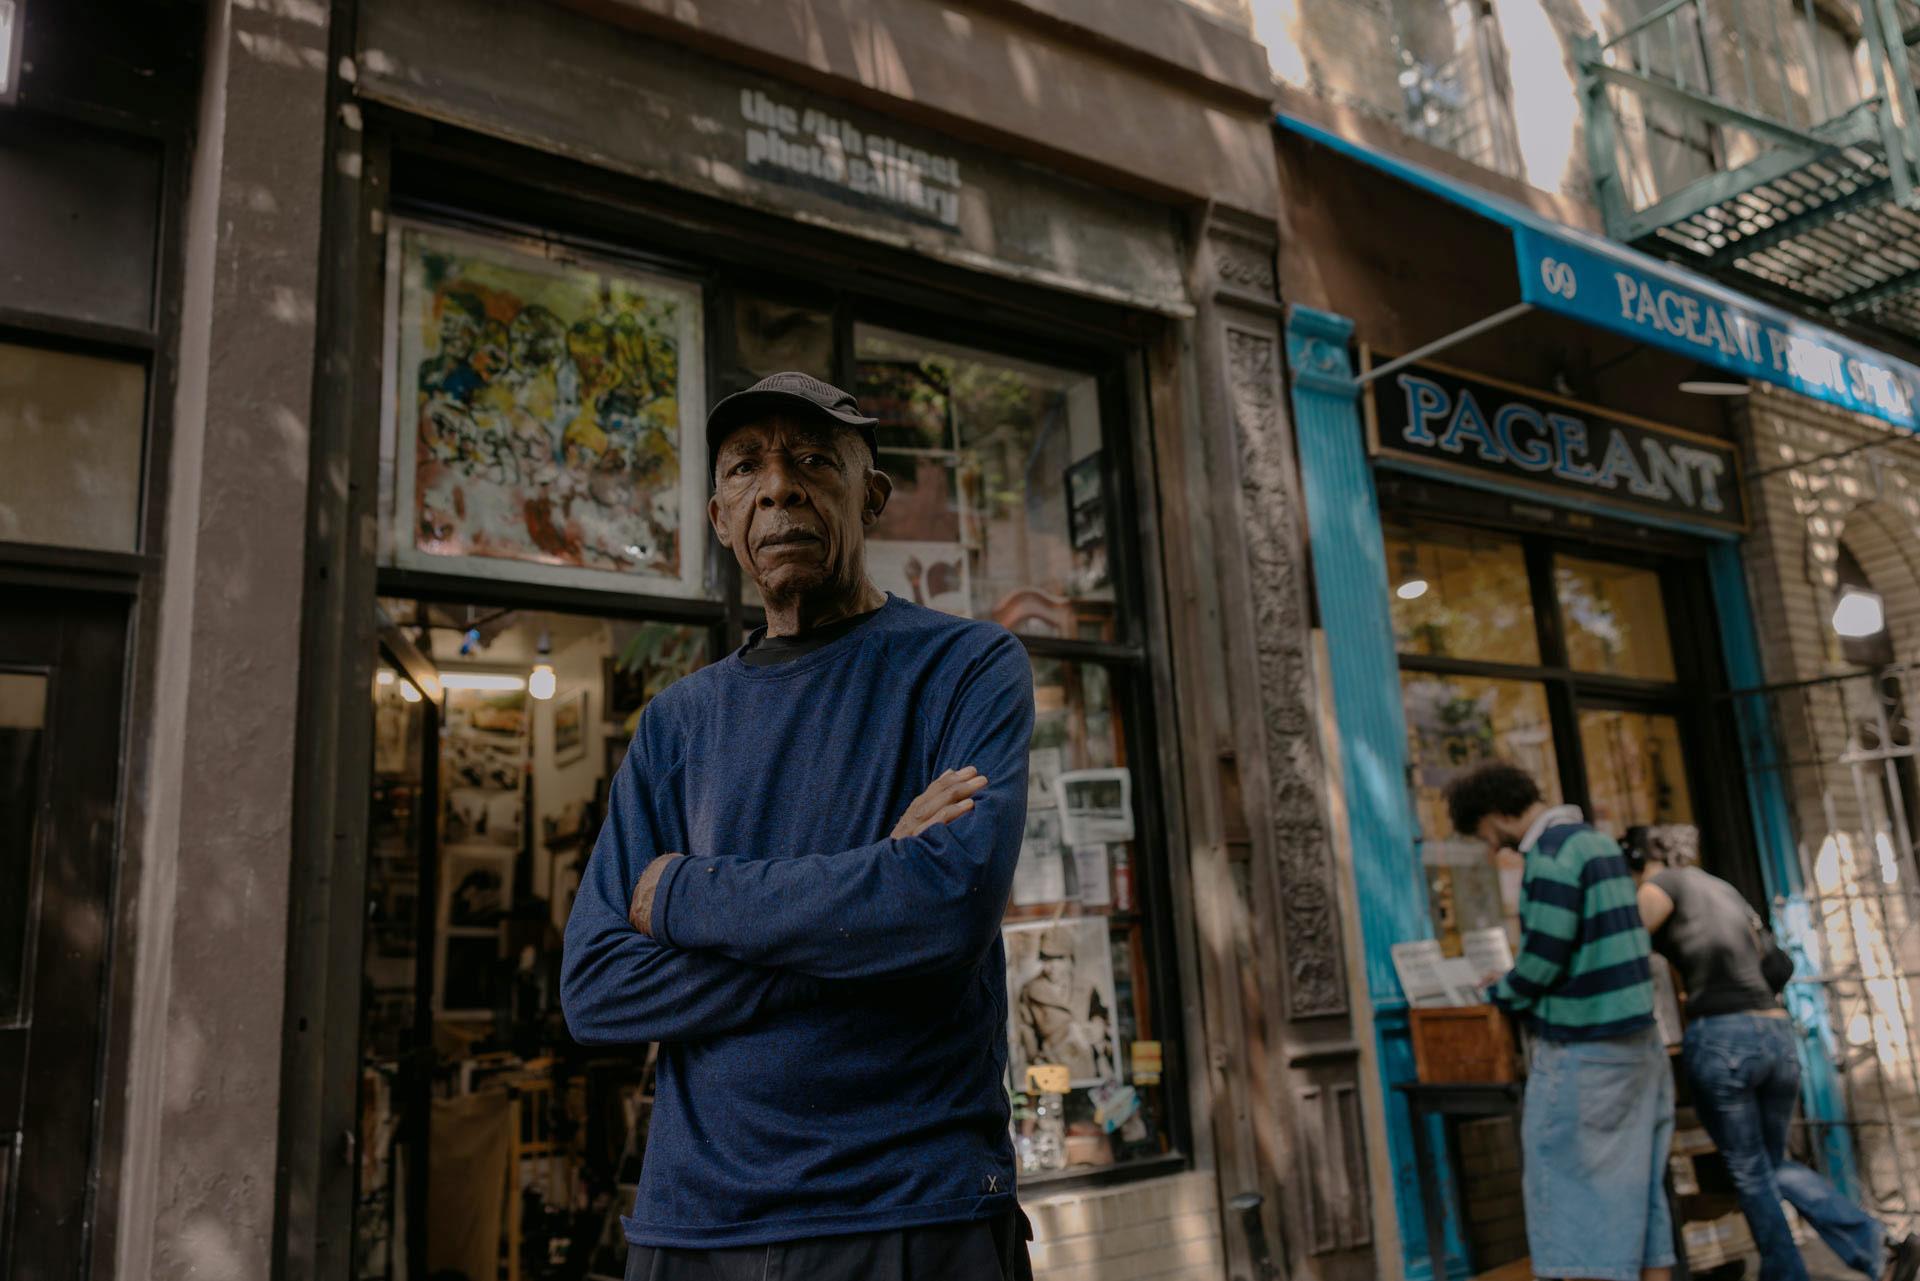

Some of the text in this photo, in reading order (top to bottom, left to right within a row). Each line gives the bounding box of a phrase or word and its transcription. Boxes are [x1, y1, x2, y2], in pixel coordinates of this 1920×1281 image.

[740, 88, 798, 135] the
[865, 134, 962, 188] street
[746, 128, 845, 183] photo
[1540, 257, 1577, 299] 69
[1614, 272, 1764, 364] PAGEANT
[1397, 373, 1725, 513] PAGEANT
